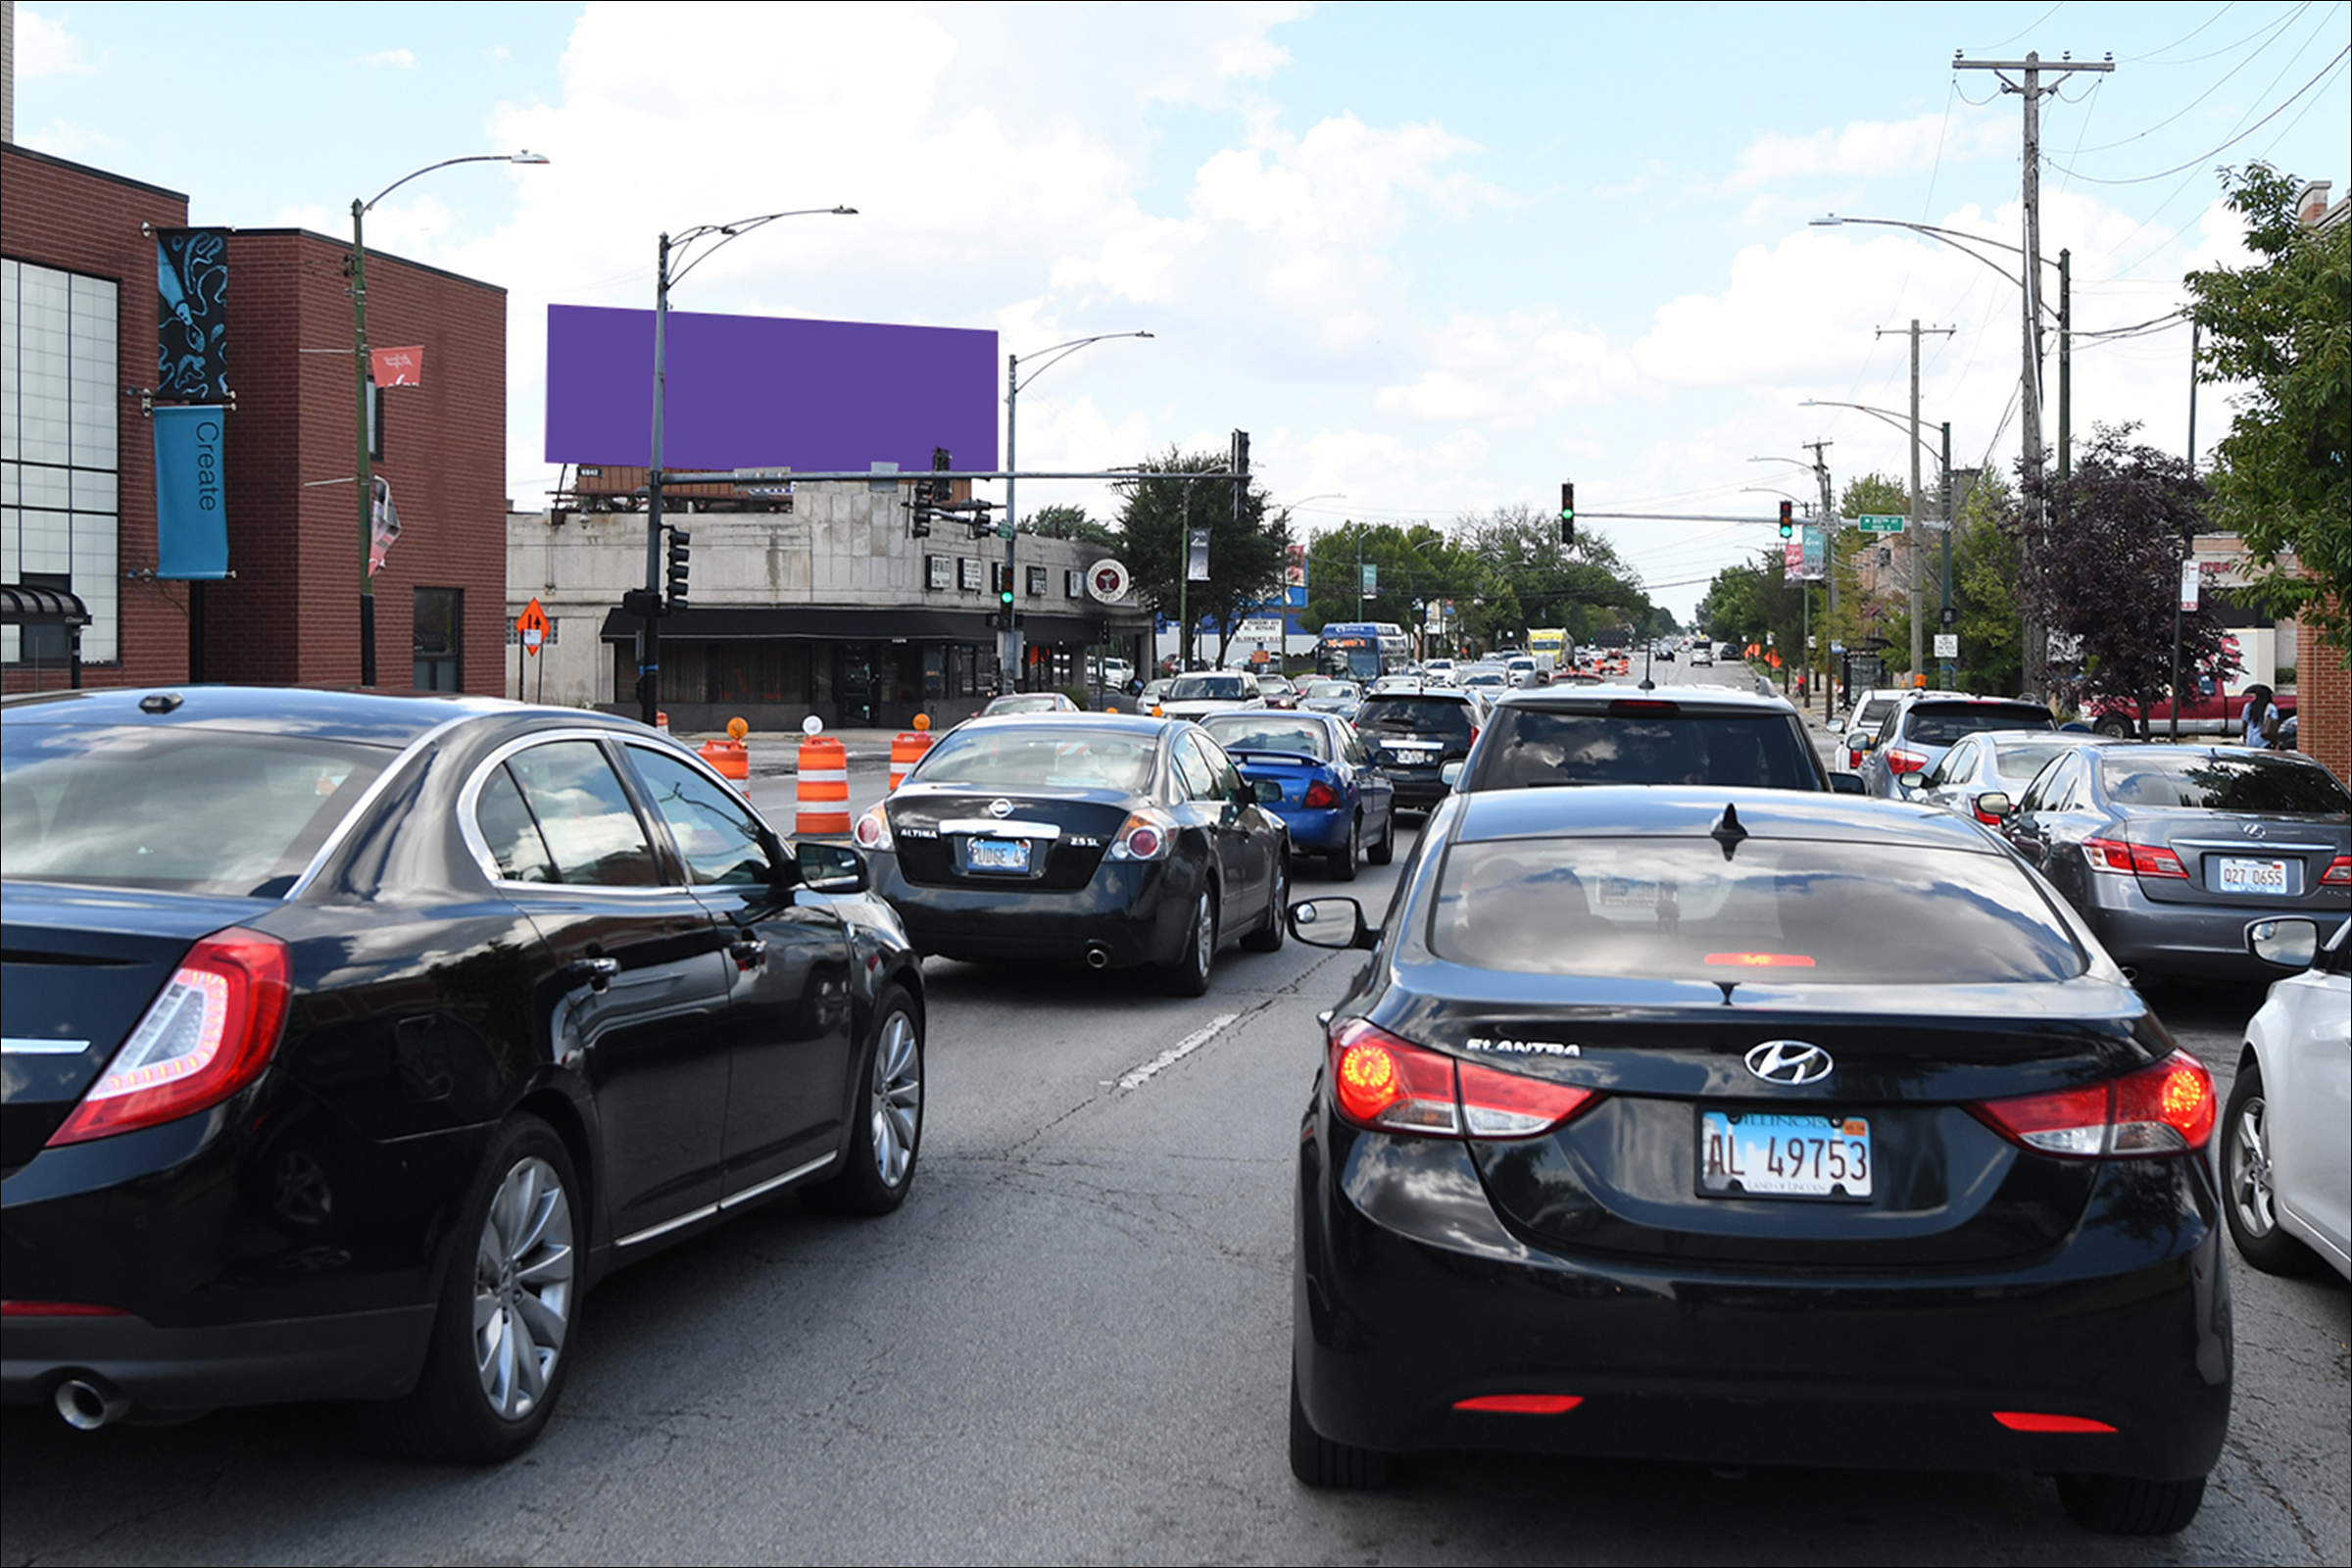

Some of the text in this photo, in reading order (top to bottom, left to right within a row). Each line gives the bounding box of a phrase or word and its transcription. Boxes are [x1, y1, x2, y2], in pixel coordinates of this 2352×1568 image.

[196, 421, 220, 512] Create
[901, 828, 938, 839] ALTIMA
[1466, 1038, 1581, 1057] ELANTRA
[1708, 1133, 1867, 1181] AL 49753
